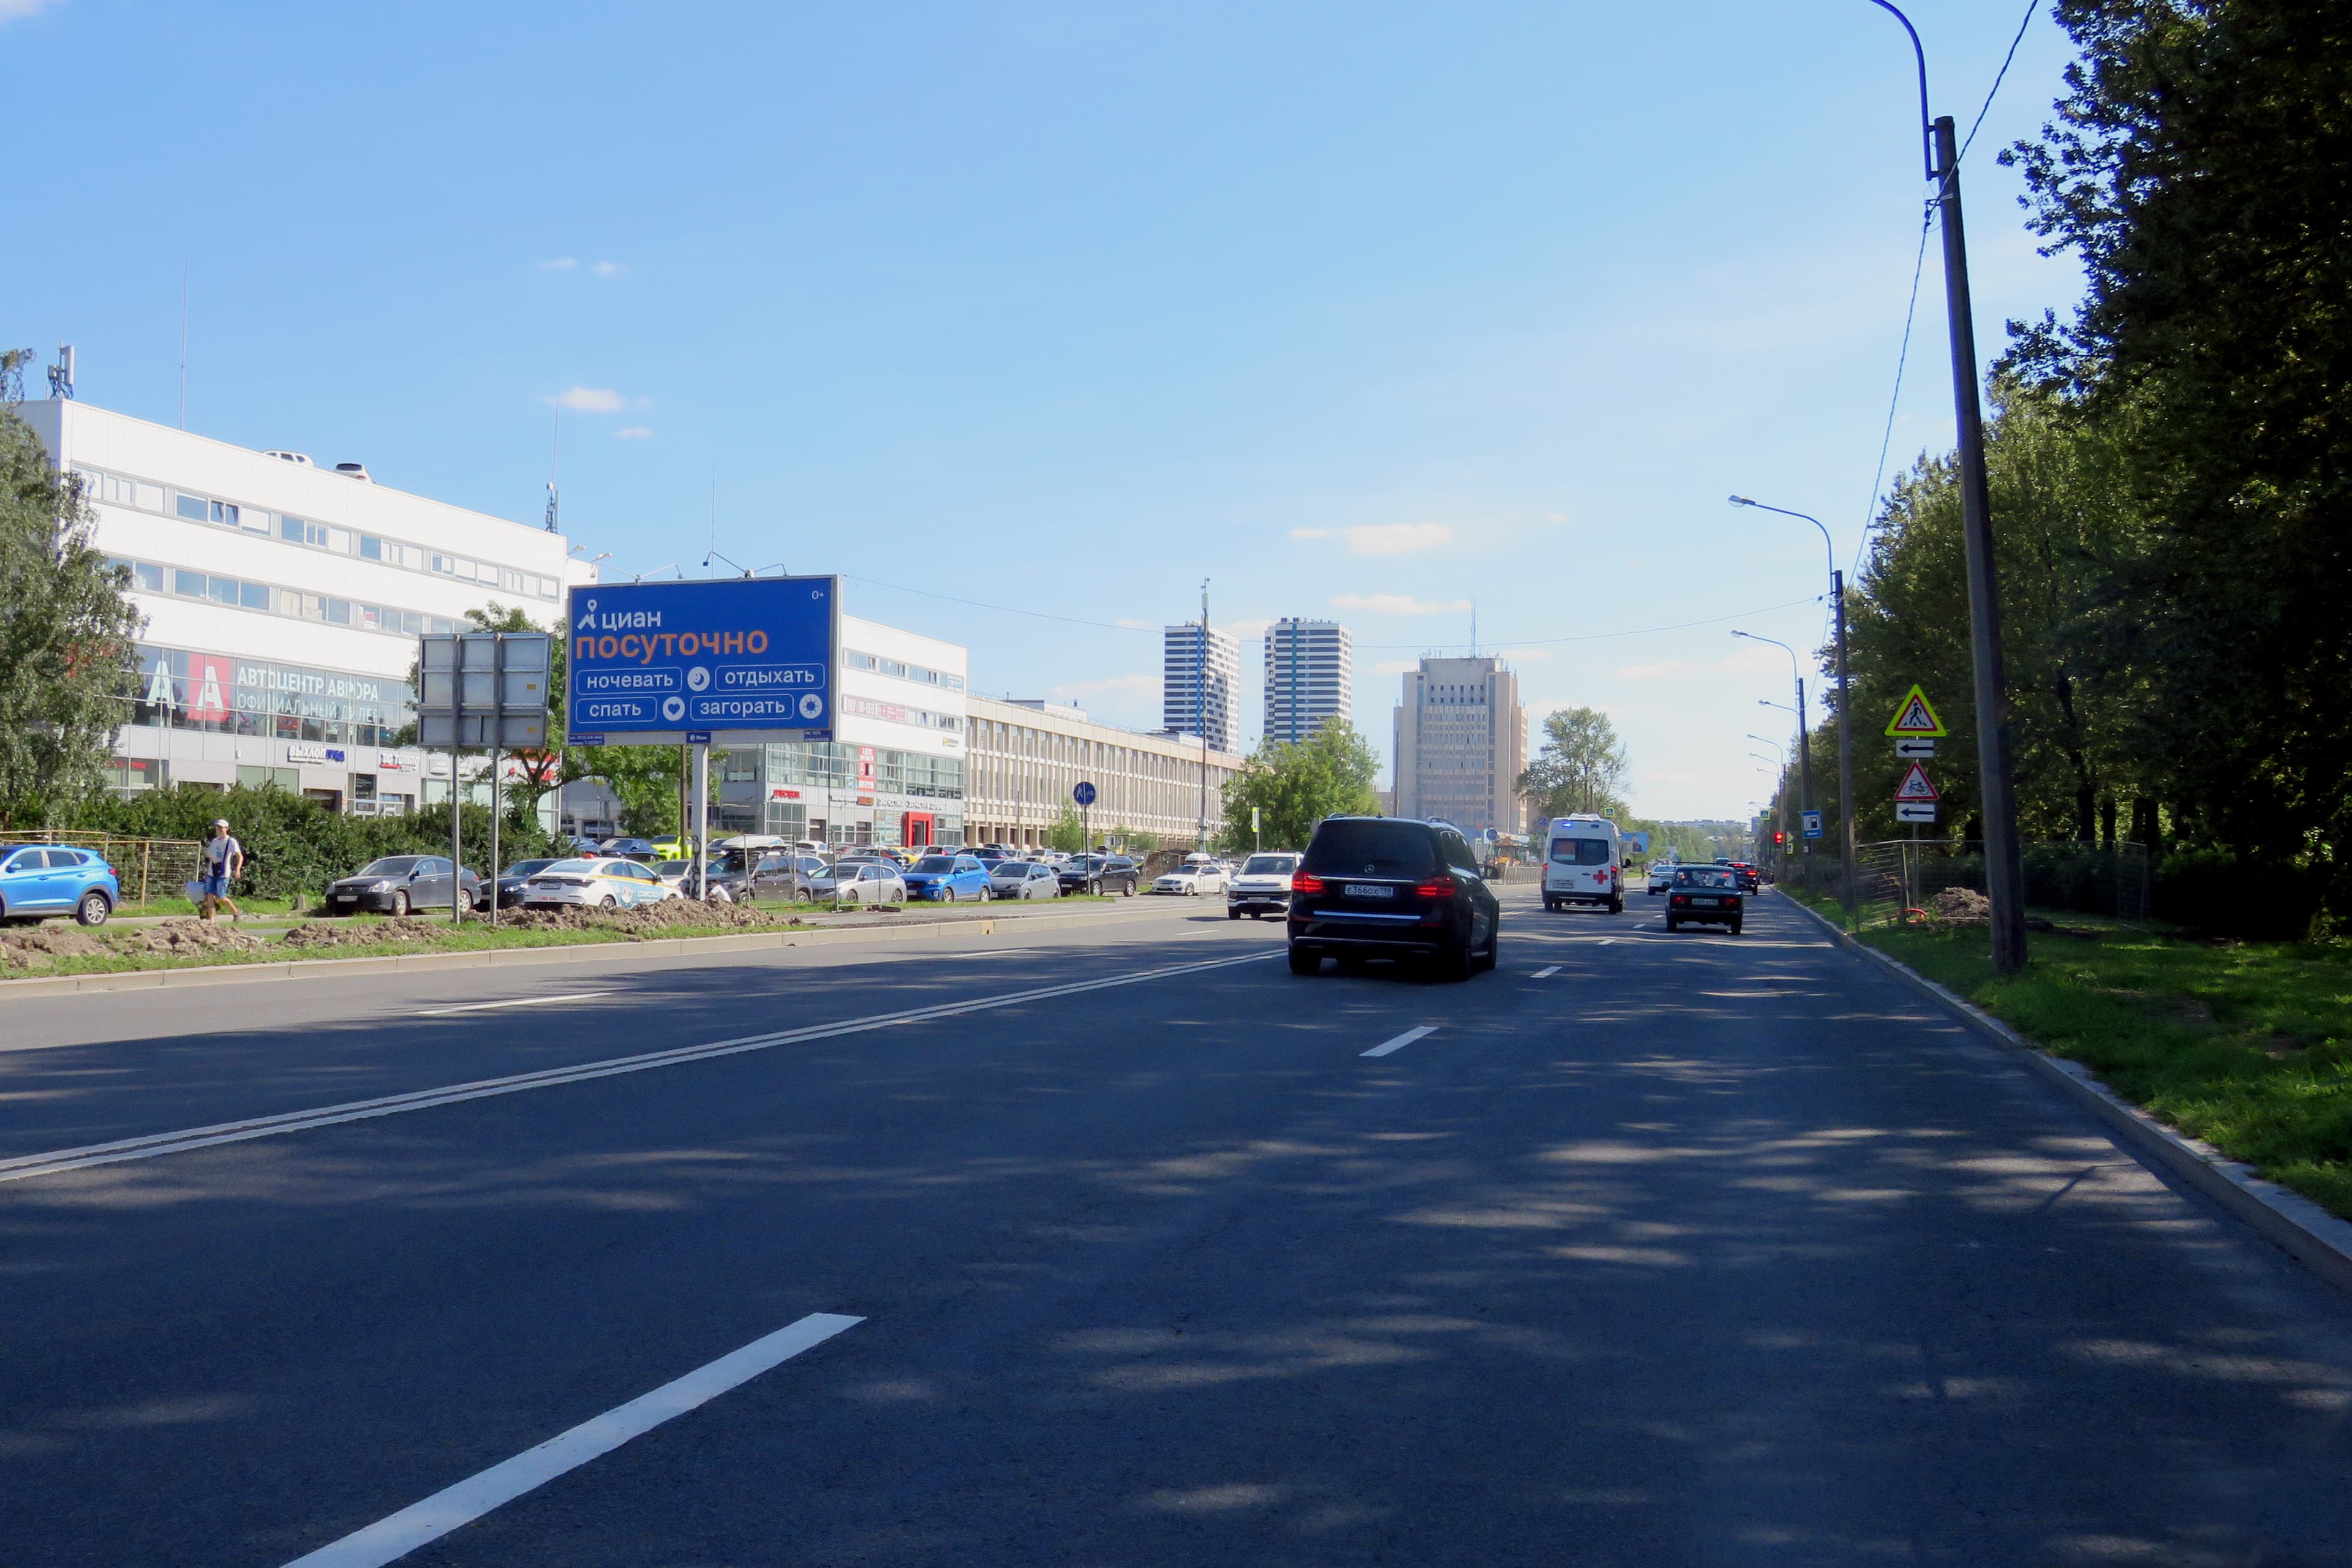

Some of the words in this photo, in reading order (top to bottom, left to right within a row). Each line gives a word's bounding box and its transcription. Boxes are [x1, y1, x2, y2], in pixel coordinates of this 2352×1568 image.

[812, 590, 824, 600] 0+
[601, 611, 662, 631] циан
[576, 630, 768, 665] посуточно
[237, 666, 324, 693] АВТОЦЕНТР
[327, 678, 379, 701] АВРОРА
[587, 674, 673, 688] ночевать
[725, 669, 815, 686] отдыхать
[238, 693, 337, 719] ОФИЦИАЛЬНЫЙ
[589, 702, 642, 718] спать
[700, 700, 785, 718] загорать
